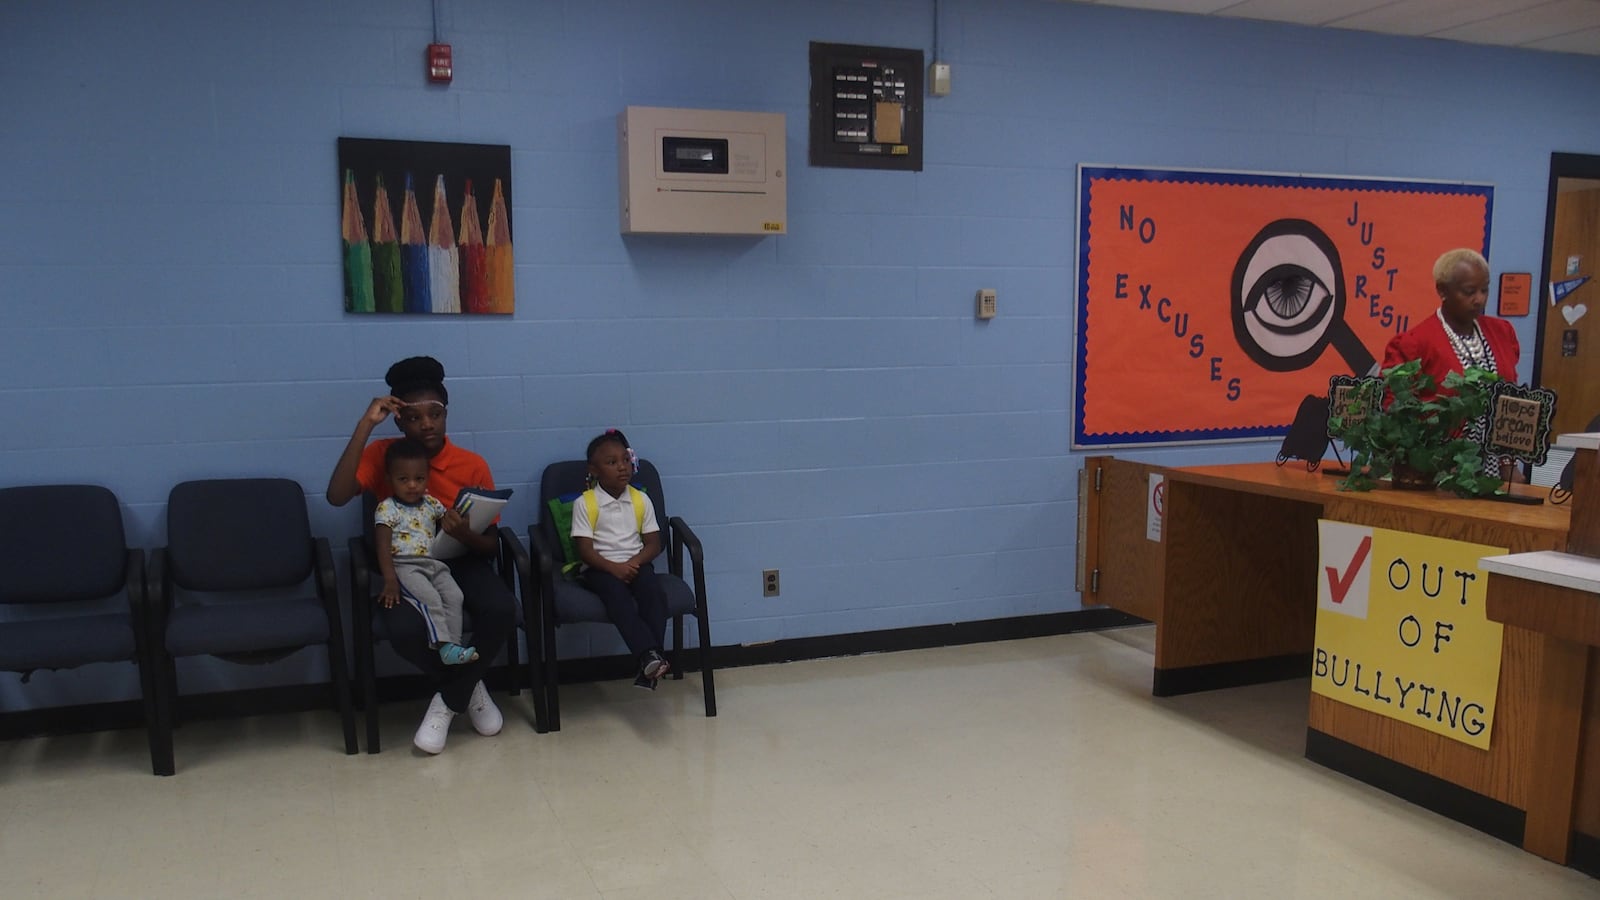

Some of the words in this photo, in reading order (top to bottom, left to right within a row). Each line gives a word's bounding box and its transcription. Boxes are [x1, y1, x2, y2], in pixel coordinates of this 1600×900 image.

[1119, 204, 1156, 244] NO
[1347, 201, 1399, 292] JUST
[1355, 274, 1409, 335] RESU
[1115, 273, 1241, 401] EXCUSES
[1495, 415, 1534, 435] dream
[1501, 399, 1535, 417] Hope
[1496, 431, 1532, 446] believe
[1388, 558, 1476, 605] OUT
[1399, 615, 1454, 653] OF
[1315, 648, 1485, 736] BULLYING
